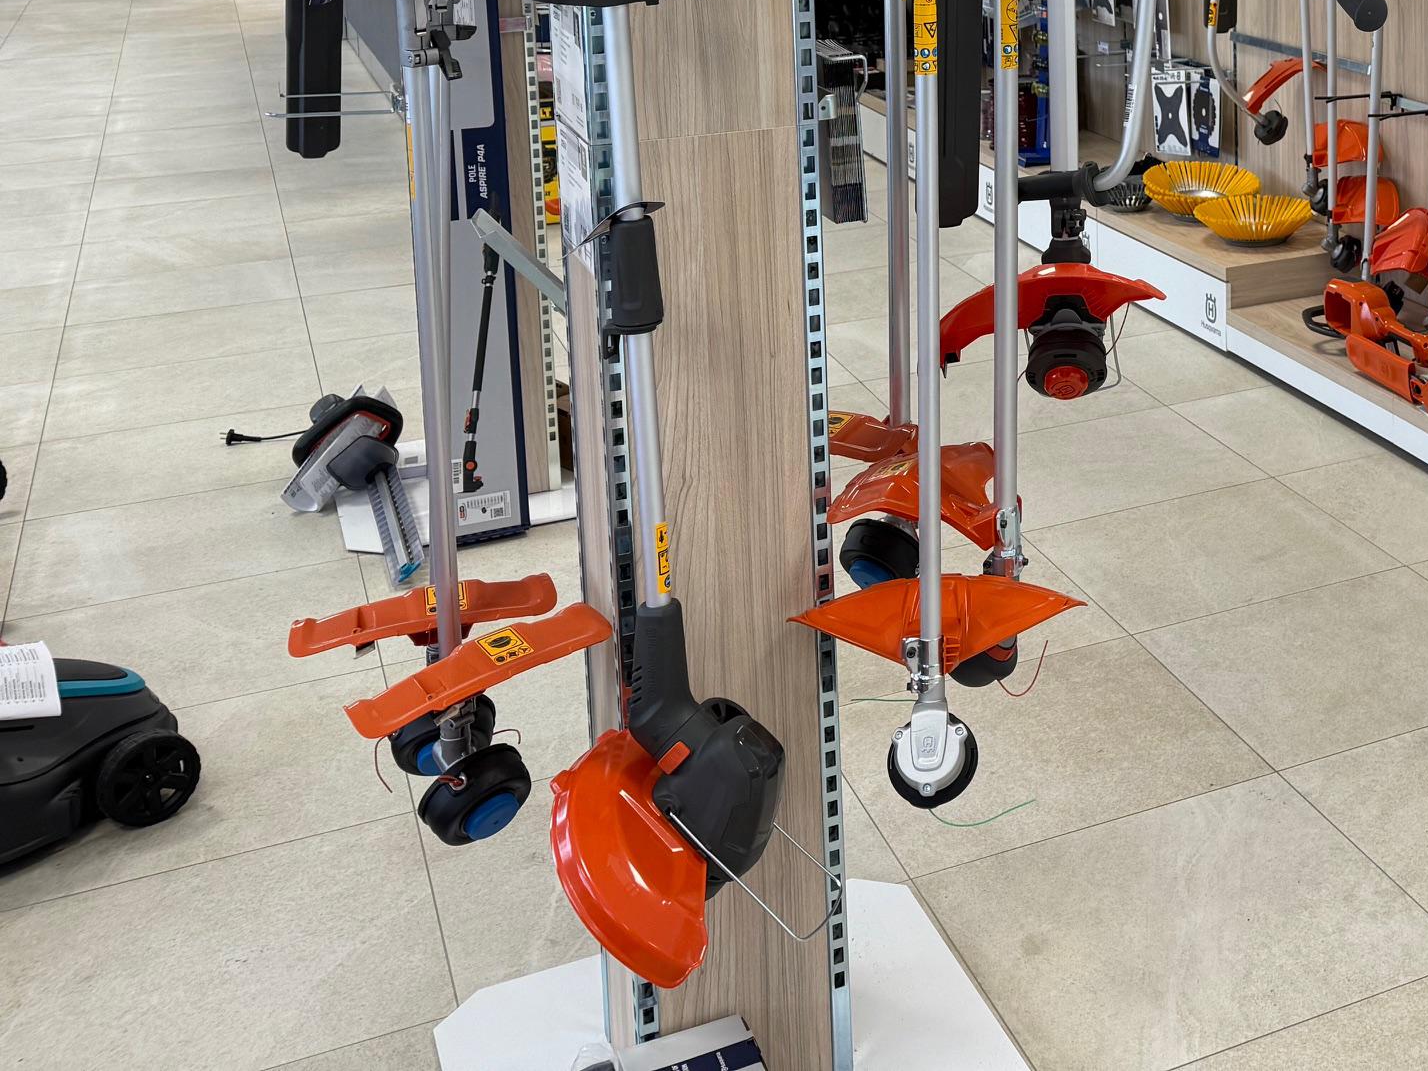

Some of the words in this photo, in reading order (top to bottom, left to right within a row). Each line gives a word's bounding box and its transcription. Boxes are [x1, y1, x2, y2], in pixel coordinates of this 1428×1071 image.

[477, 144, 486, 163] P4A
[468, 163, 477, 183] POLE
[478, 165, 488, 199] ASPIRE
